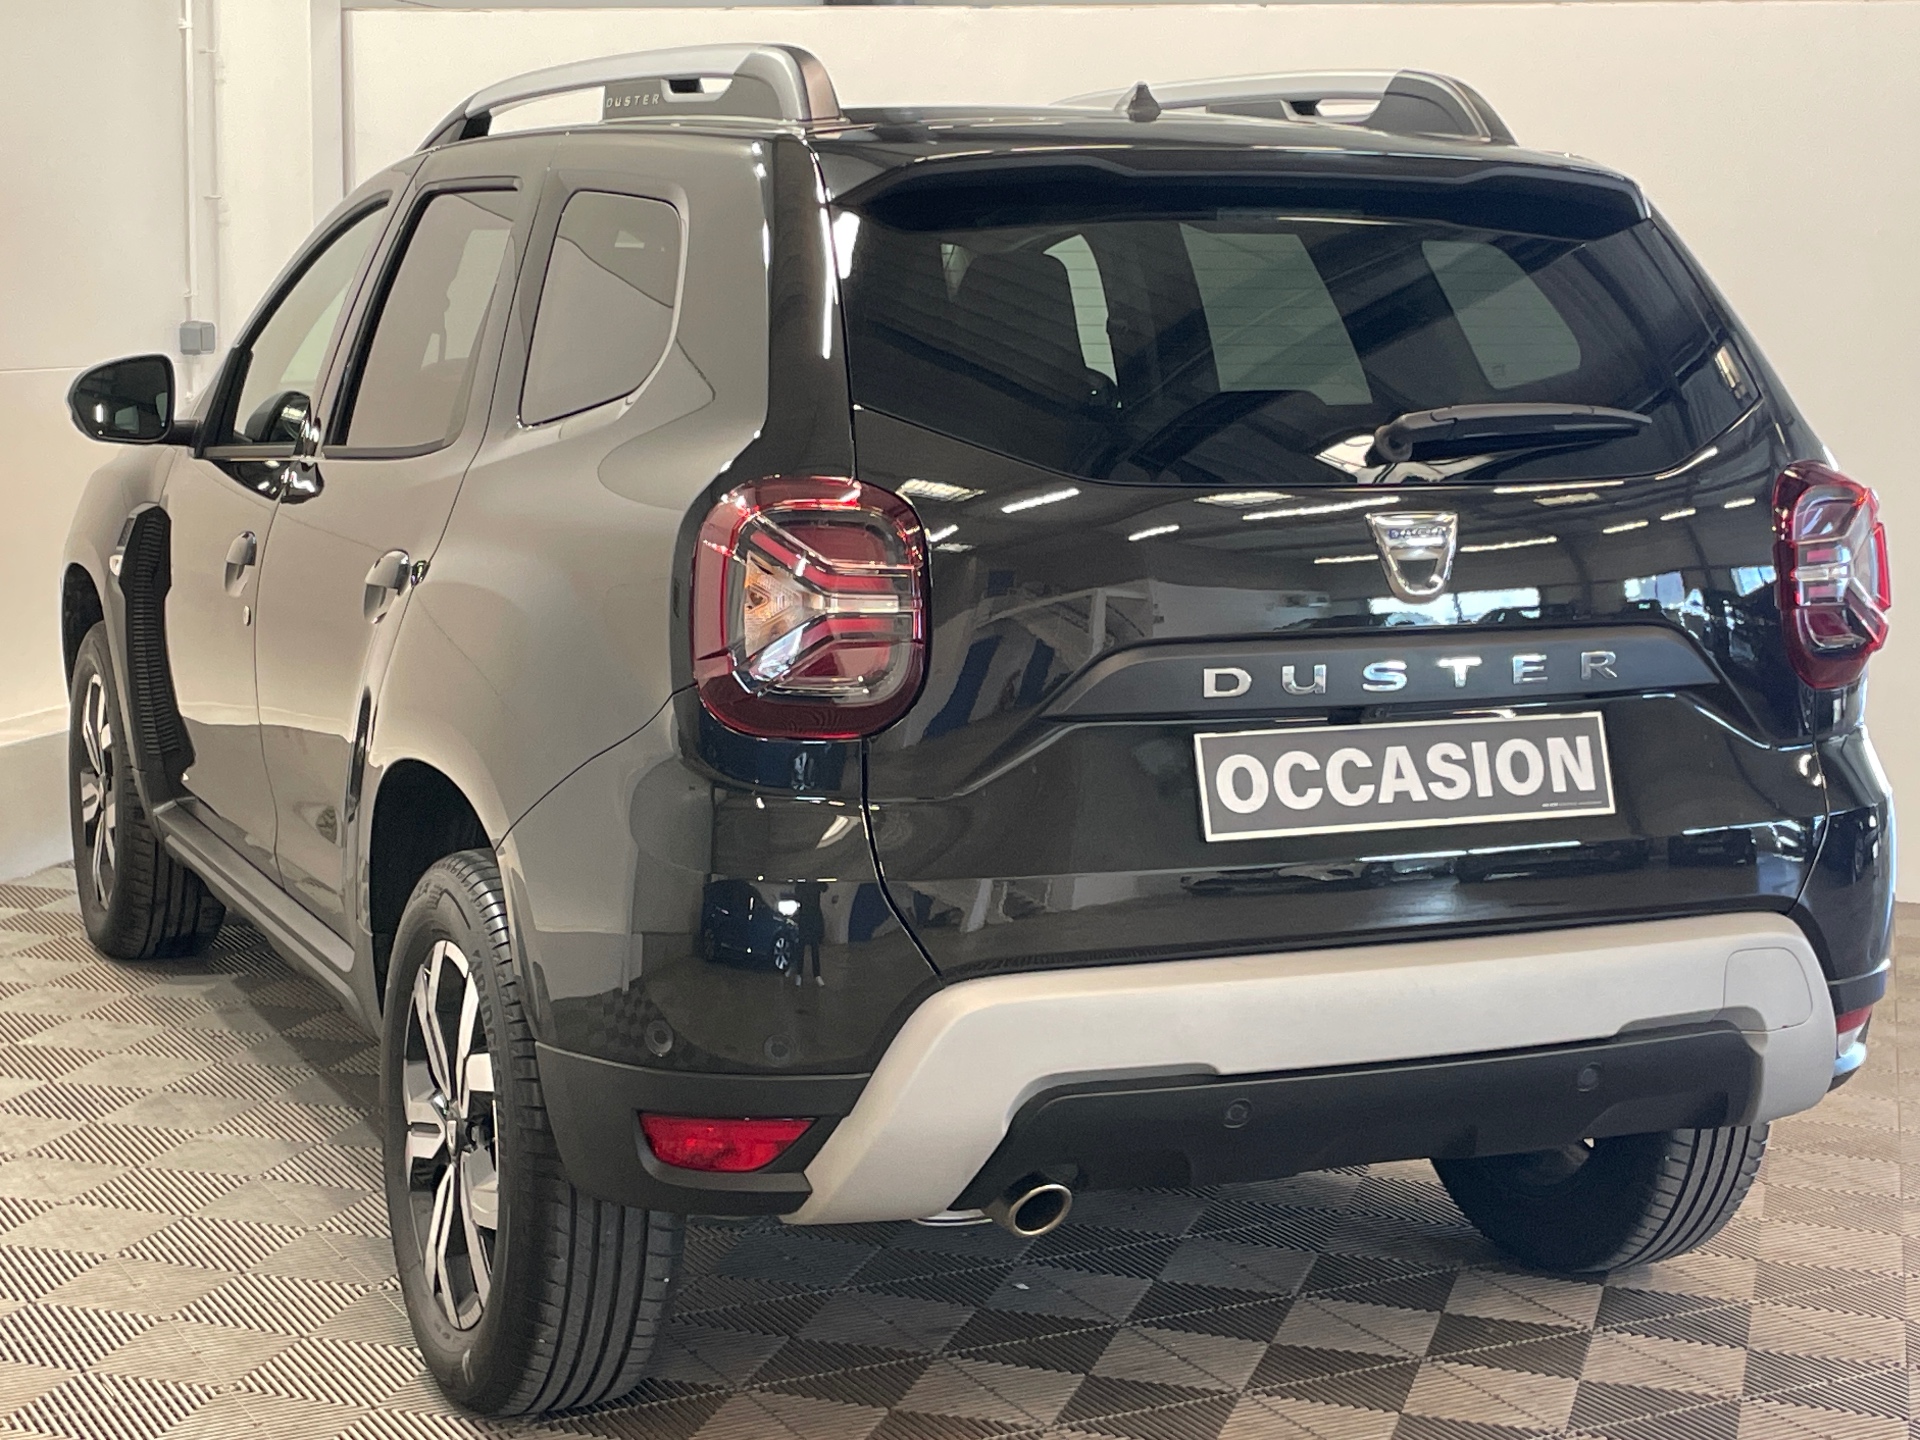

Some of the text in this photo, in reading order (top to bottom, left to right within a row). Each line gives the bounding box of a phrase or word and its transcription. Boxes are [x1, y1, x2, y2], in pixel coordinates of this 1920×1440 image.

[606, 94, 660, 108] DUSTER
[1203, 651, 1619, 698] DUSTER
[1215, 736, 1597, 814] OCCASION
